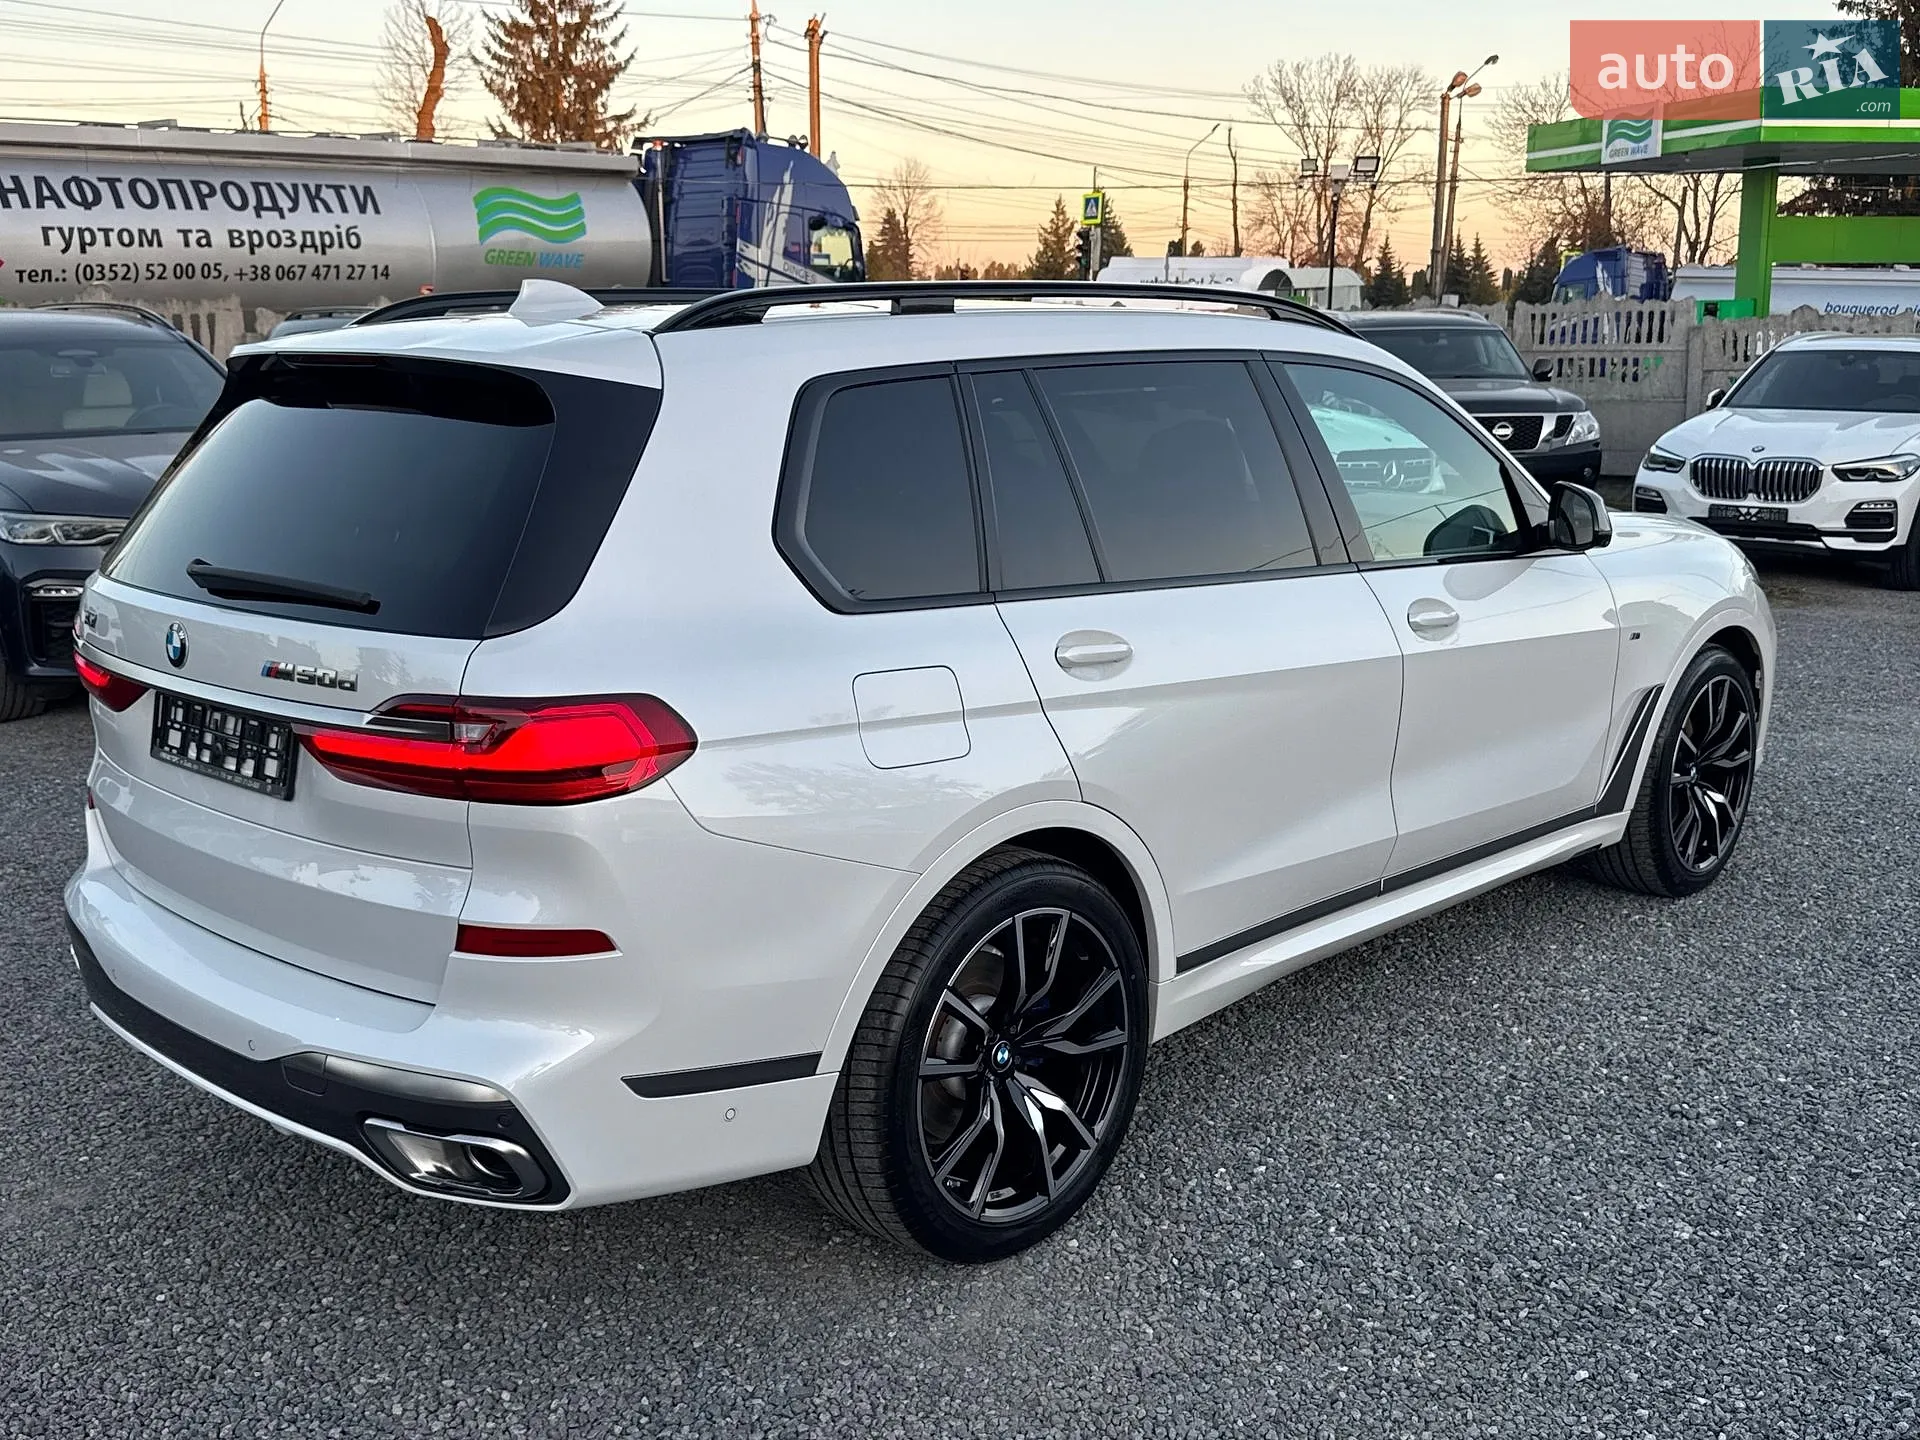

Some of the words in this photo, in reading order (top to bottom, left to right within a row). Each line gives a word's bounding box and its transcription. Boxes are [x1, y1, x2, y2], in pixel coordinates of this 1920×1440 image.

[0, 175, 381, 219] НАФТОПРОДУКТИ
[41, 226, 163, 254] гуртом
[177, 228, 213, 248] та
[227, 224, 362, 256] вроздріб
[484, 248, 536, 267] GREEN
[538, 252, 585, 269] WAVE
[15, 268, 67, 283] тел.:
[75, 262, 139, 284] (0352)
[145, 263, 168, 280] 52
[173, 263, 196, 280] 00
[201, 263, 229, 282] 05,
[234, 264, 271, 282] +38
[275, 264, 307, 281] 067
[311, 264, 341, 281] 471
[346, 264, 366, 281] 27
[372, 264, 391, 281] 14
